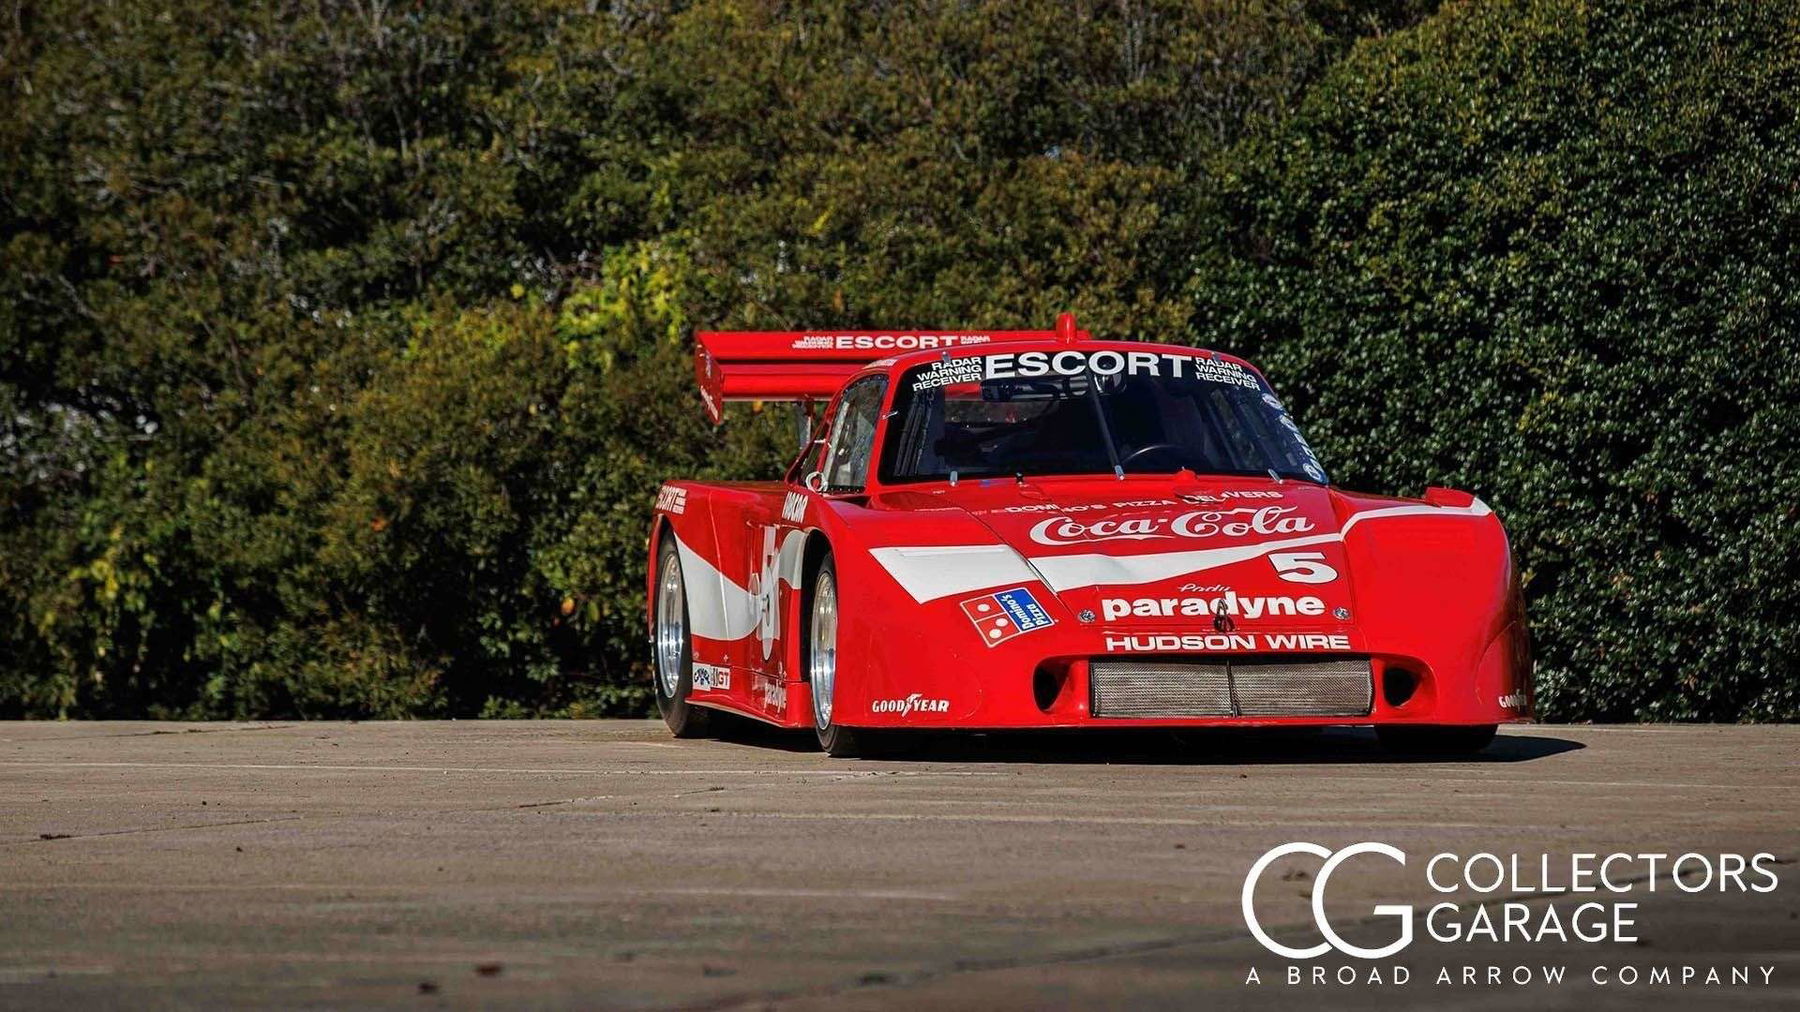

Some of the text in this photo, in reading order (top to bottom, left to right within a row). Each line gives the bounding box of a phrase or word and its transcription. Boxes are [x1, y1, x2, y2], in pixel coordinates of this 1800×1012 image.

[835, 336, 959, 349] ESCORT
[931, 356, 982, 371] RADAR
[985, 352, 1192, 378] ESCORT
[1195, 357, 1243, 372] RADAR
[912, 373, 982, 391] RECEIVER
[916, 365, 982, 382] WARNING
[1195, 372, 1261, 391] RECEIVER
[1196, 364, 1257, 383] WARNING
[1112, 498, 1178, 508] PIZZA
[1030, 506, 1314, 545] Coca-Cola
[1268, 552, 1338, 584] 5
[1000, 594, 1036, 630] Domino's
[1026, 603, 1050, 626] Pizza
[1102, 591, 1326, 621] paradyne
[1106, 634, 1351, 651] HUDSON WIRE
